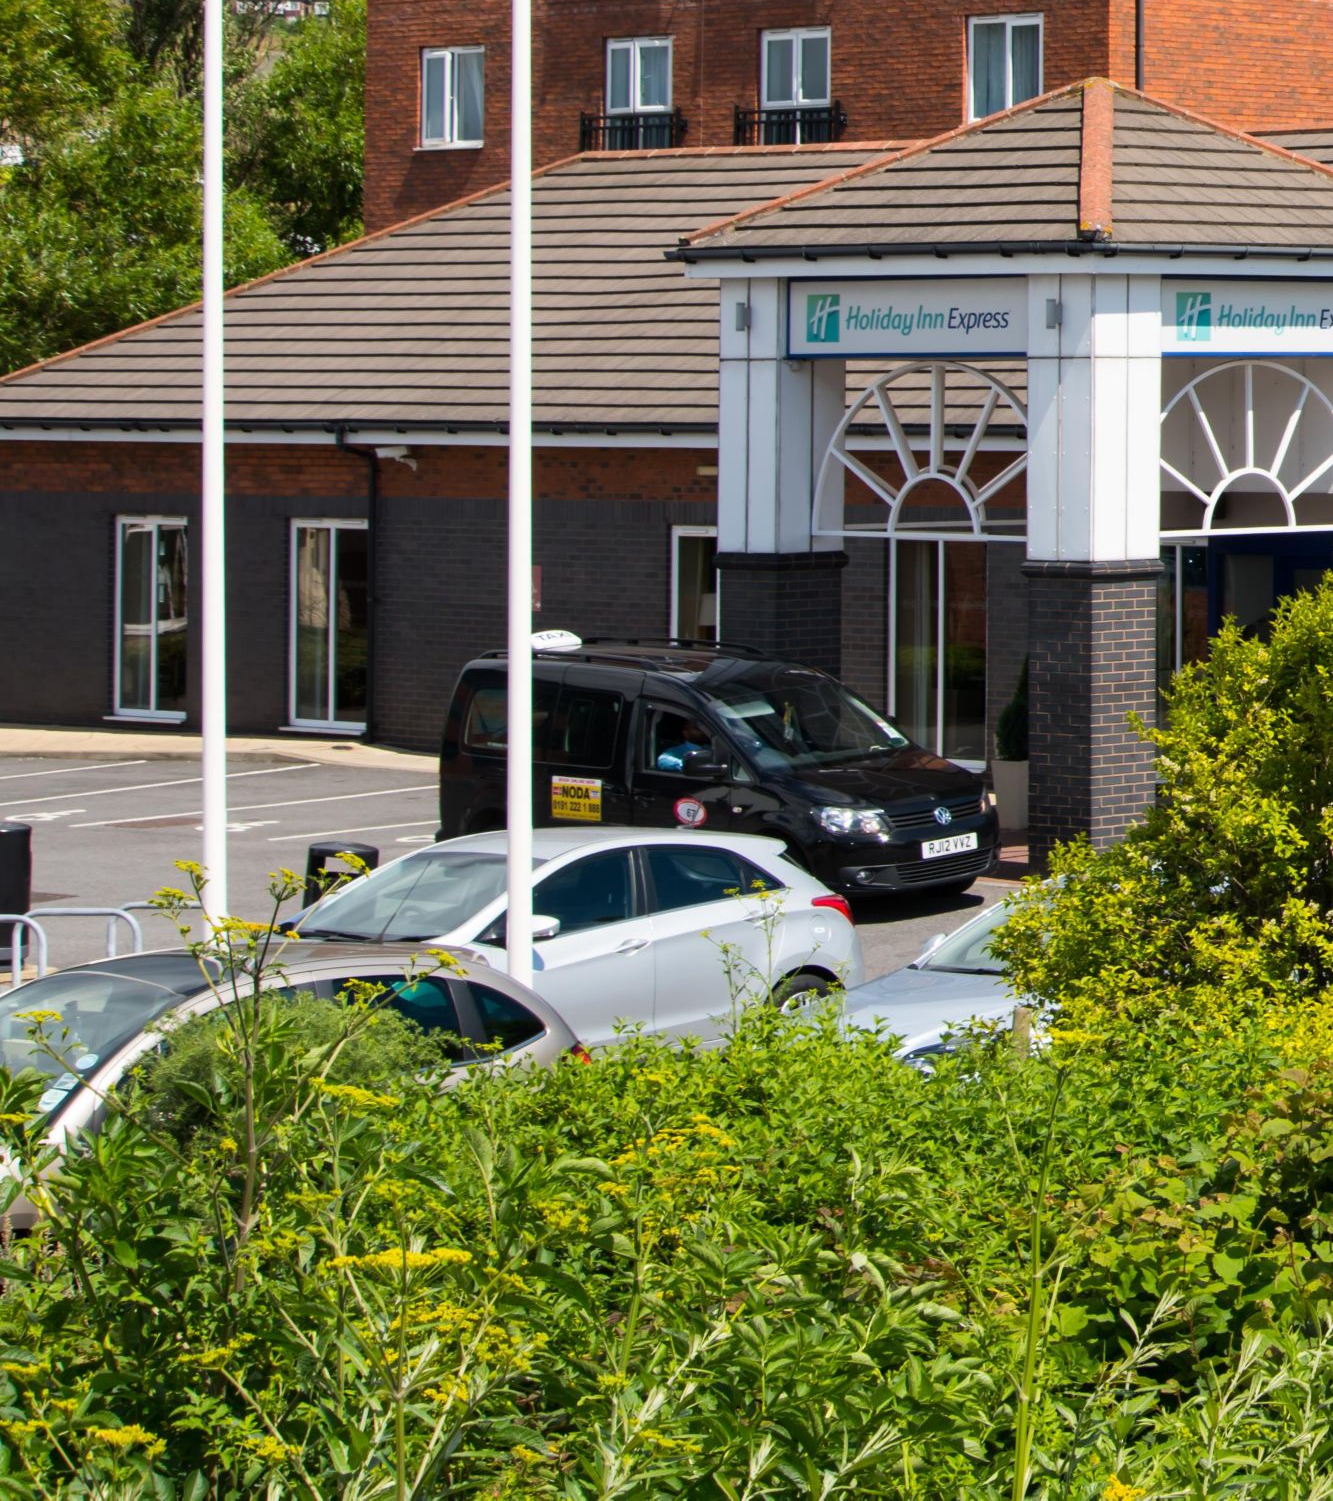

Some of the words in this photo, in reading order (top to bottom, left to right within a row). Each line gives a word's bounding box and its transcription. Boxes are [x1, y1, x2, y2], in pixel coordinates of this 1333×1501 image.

[846, 304, 915, 336] Holiday
[916, 304, 945, 330] Inn
[948, 307, 1010, 335] Express
[1217, 303, 1287, 336] Holiday
[1289, 305, 1317, 329] Inn
[562, 785, 591, 800] NODA
[928, 840, 951, 854] RJ12
